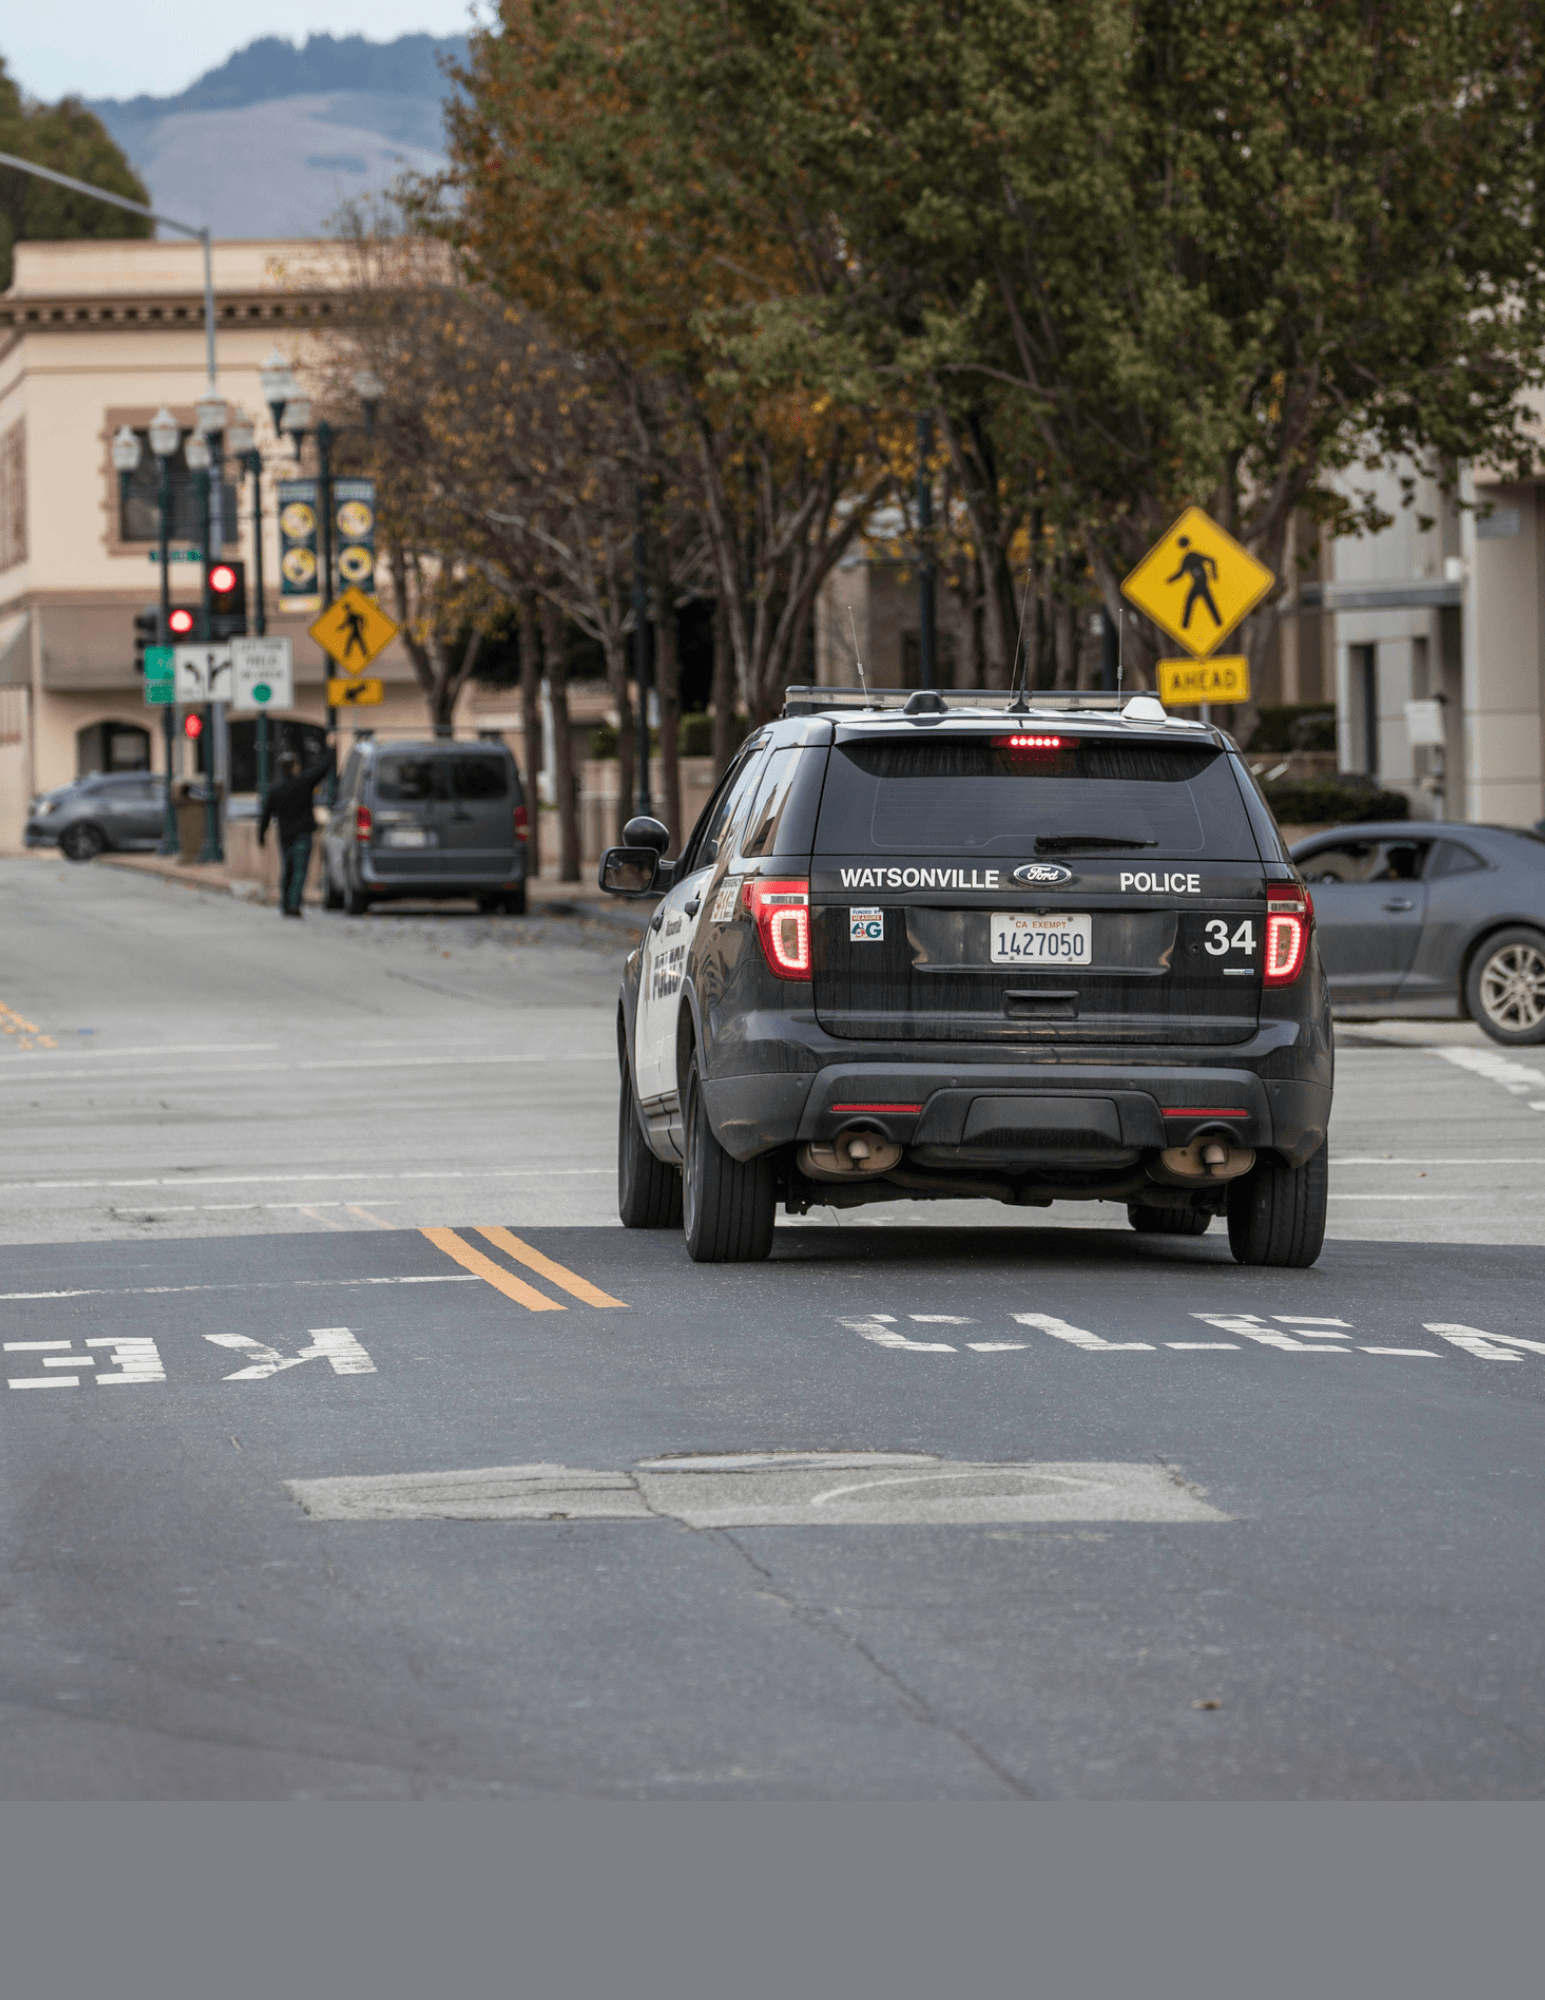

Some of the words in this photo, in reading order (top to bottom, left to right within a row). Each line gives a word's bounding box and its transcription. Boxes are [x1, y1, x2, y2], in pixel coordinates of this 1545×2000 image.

[1170, 668, 1237, 691] AHEAD
[840, 867, 1000, 889] WATSONVILLE
[1026, 866, 1059, 883] Ford
[1120, 872, 1201, 894] POLICE
[1015, 921, 1028, 929] CA
[1032, 921, 1067, 929] EXEMPT
[997, 932, 1085, 957] 1427050
[1204, 919, 1257, 956] 34
